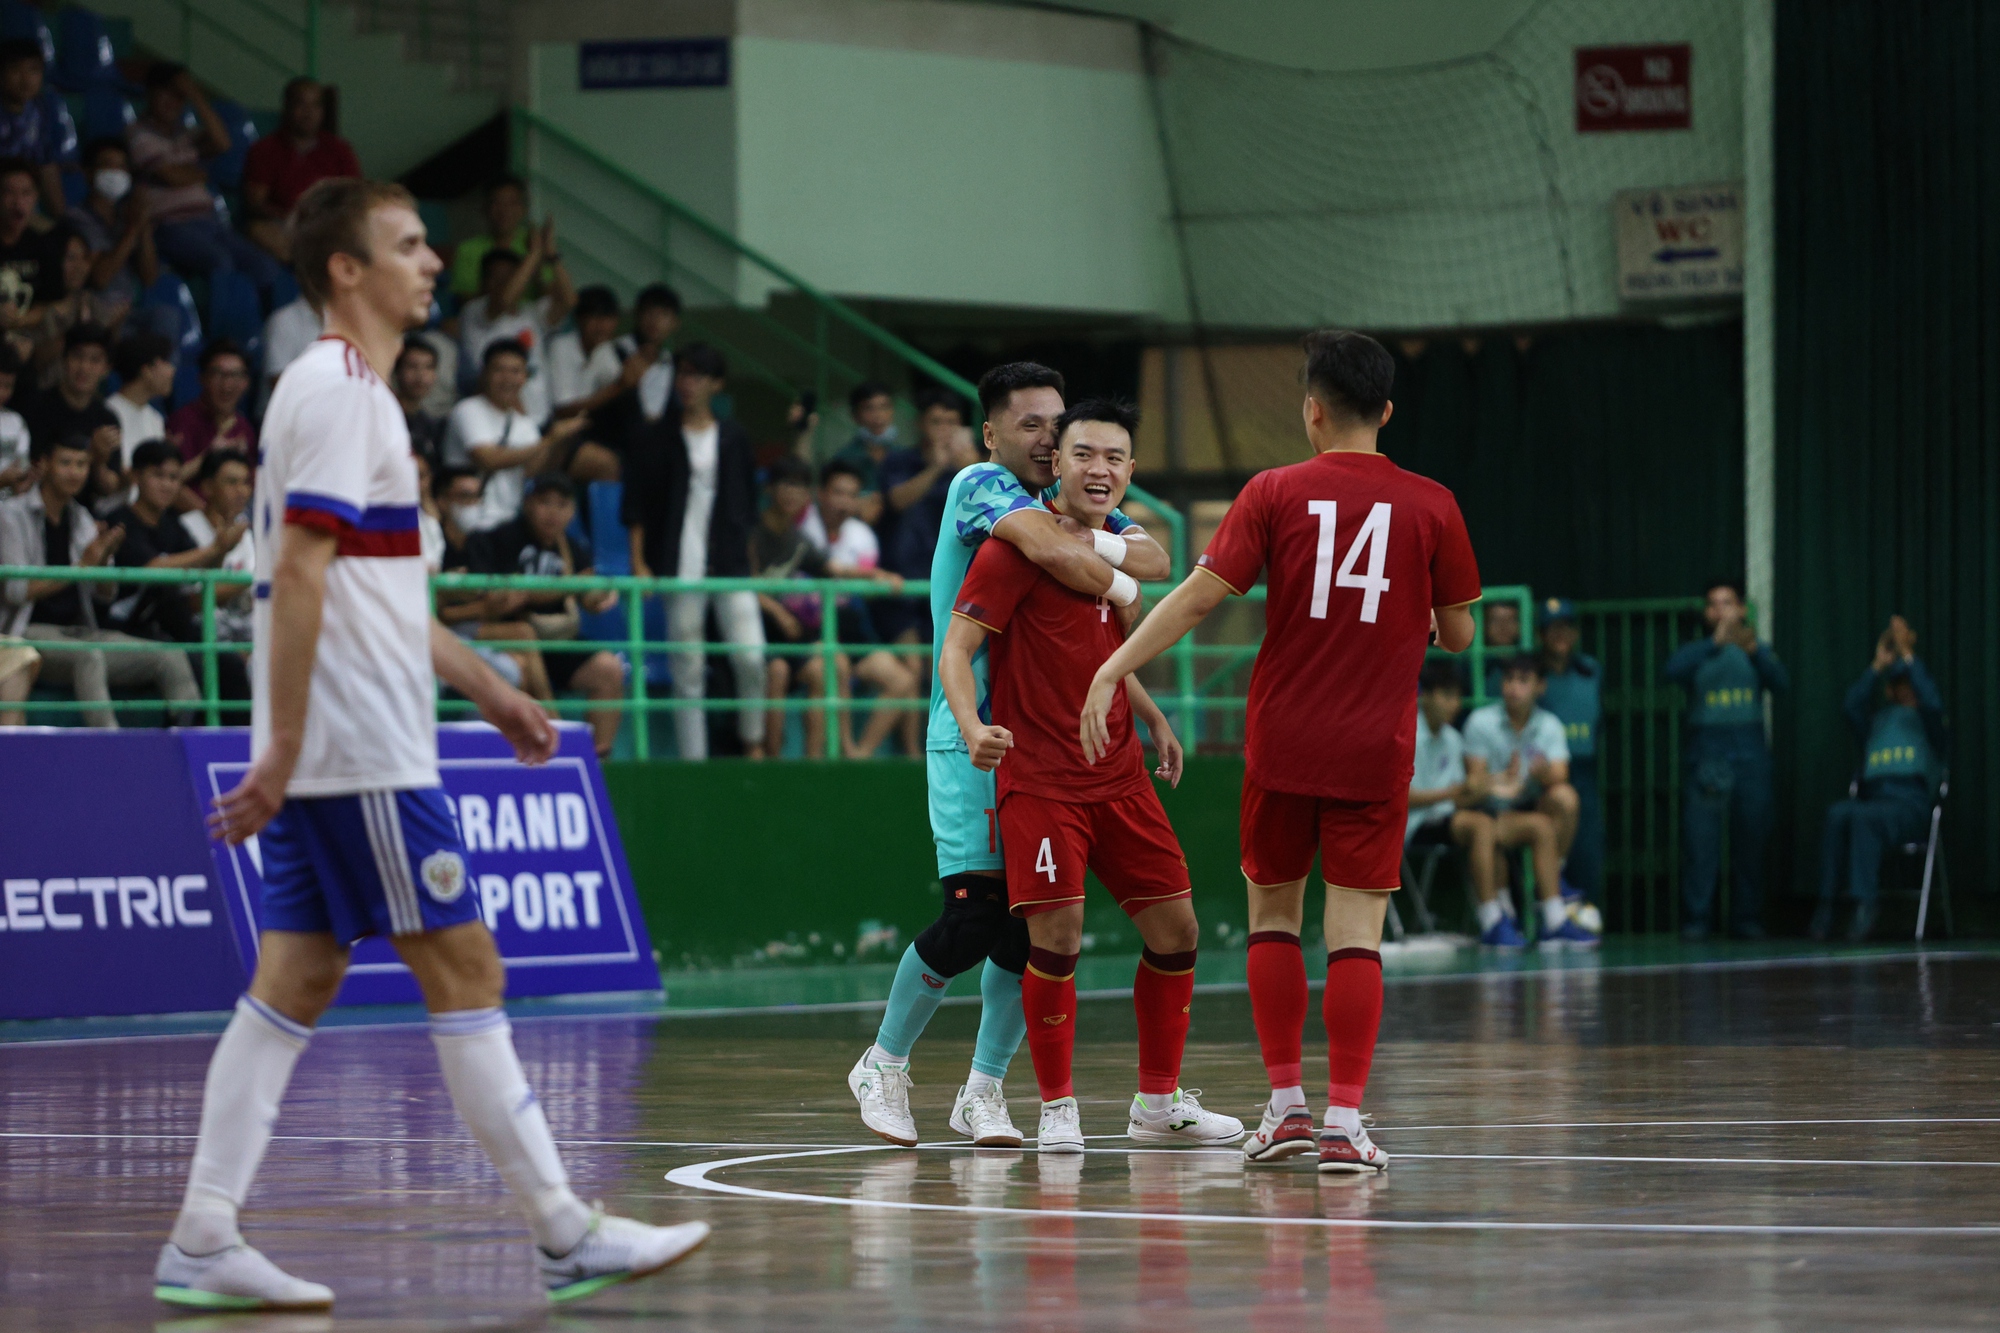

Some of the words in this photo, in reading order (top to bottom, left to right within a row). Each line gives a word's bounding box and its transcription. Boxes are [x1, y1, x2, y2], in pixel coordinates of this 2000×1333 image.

[1656, 218, 1712, 242] WC
[1308, 500, 1392, 623] 14
[444, 792, 590, 852] RAND
[1035, 836, 1057, 883] 4
[0, 874, 212, 931] ECTRIC
[468, 870, 604, 933] PORT
